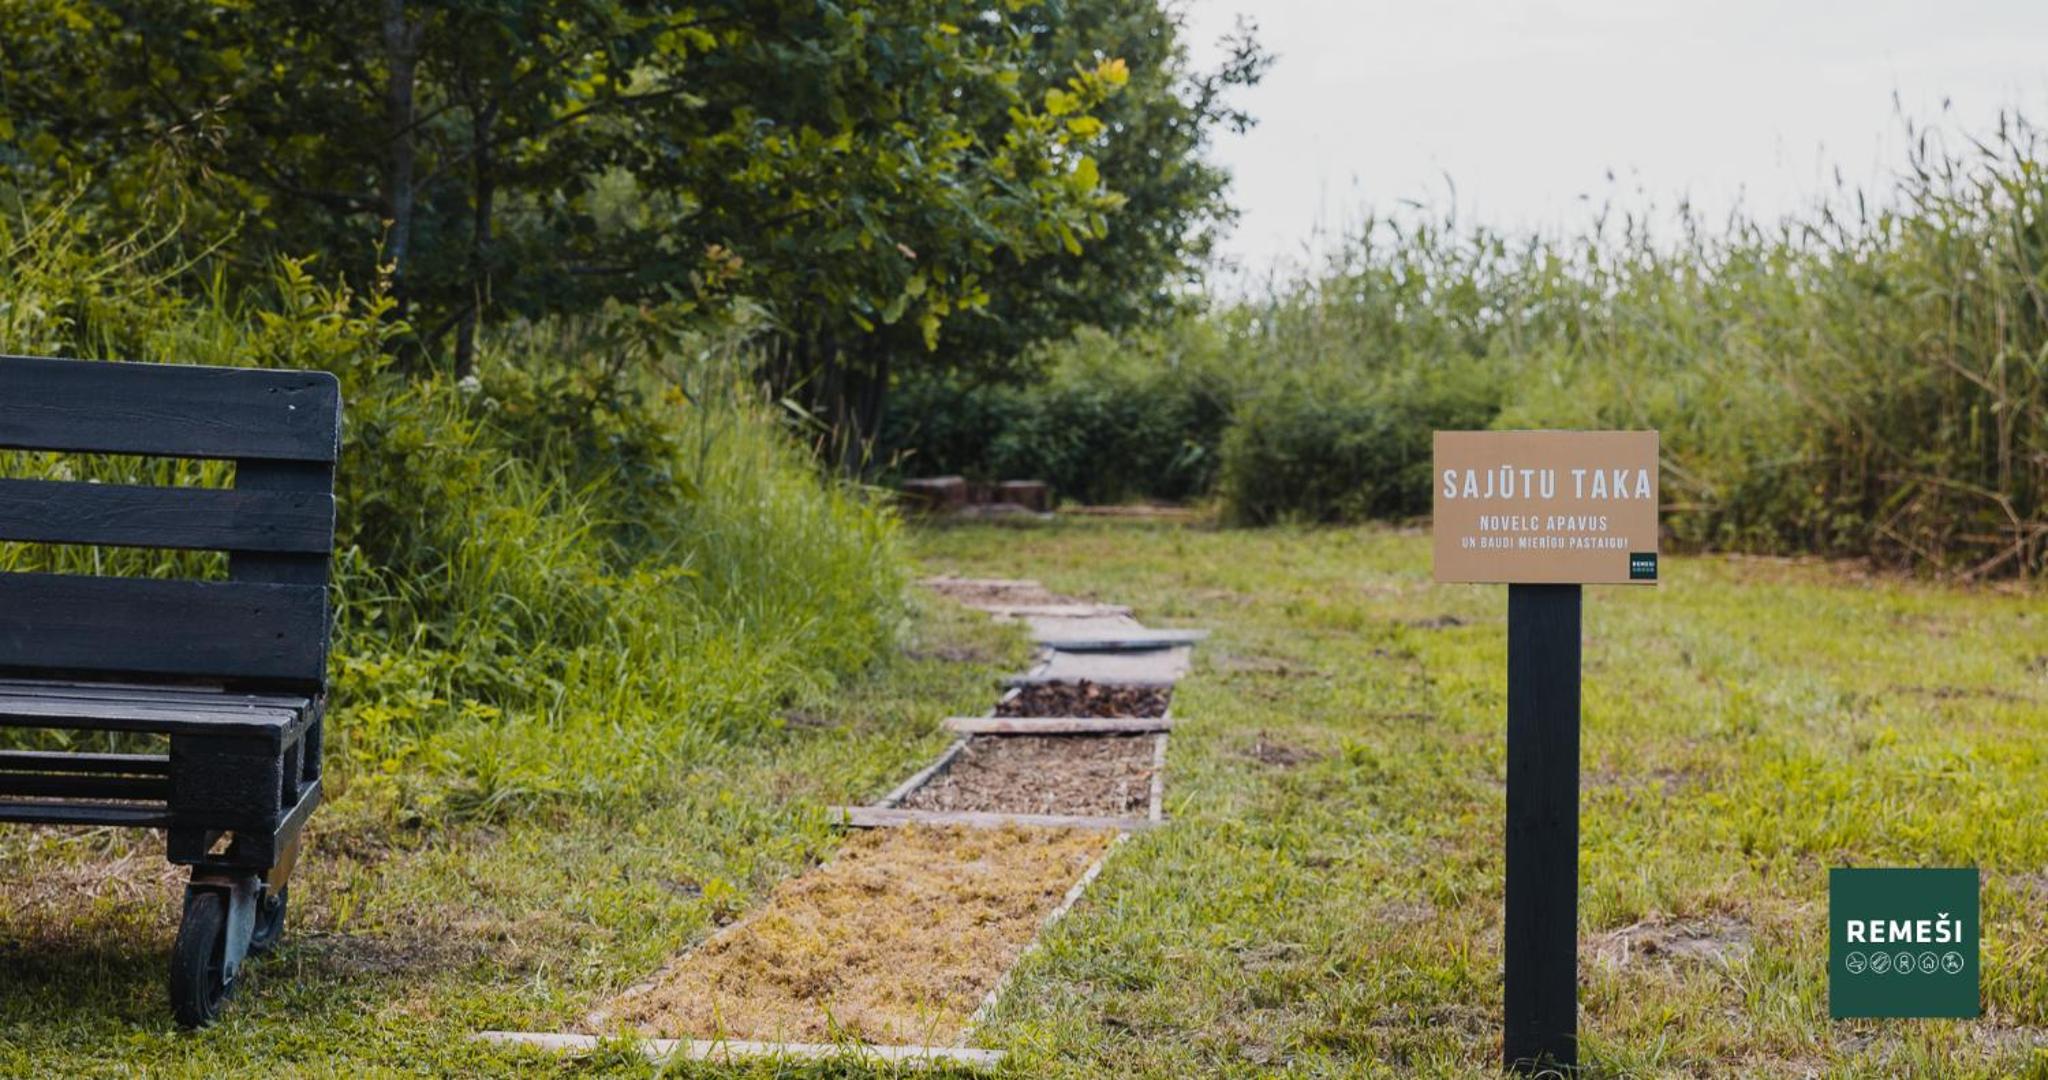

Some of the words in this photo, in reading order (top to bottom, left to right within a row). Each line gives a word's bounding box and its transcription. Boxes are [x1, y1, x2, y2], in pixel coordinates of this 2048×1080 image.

[1443, 465, 1555, 499] SAJŪTU
[1572, 469, 1651, 499] TAKA
[1480, 516, 1539, 531] NOVELC
[1547, 516, 1607, 531] APAVUS
[1462, 537, 1476, 549] UN
[1519, 535, 1565, 549] MIERĪGU
[1570, 537, 1628, 549] PASTAIGU!
